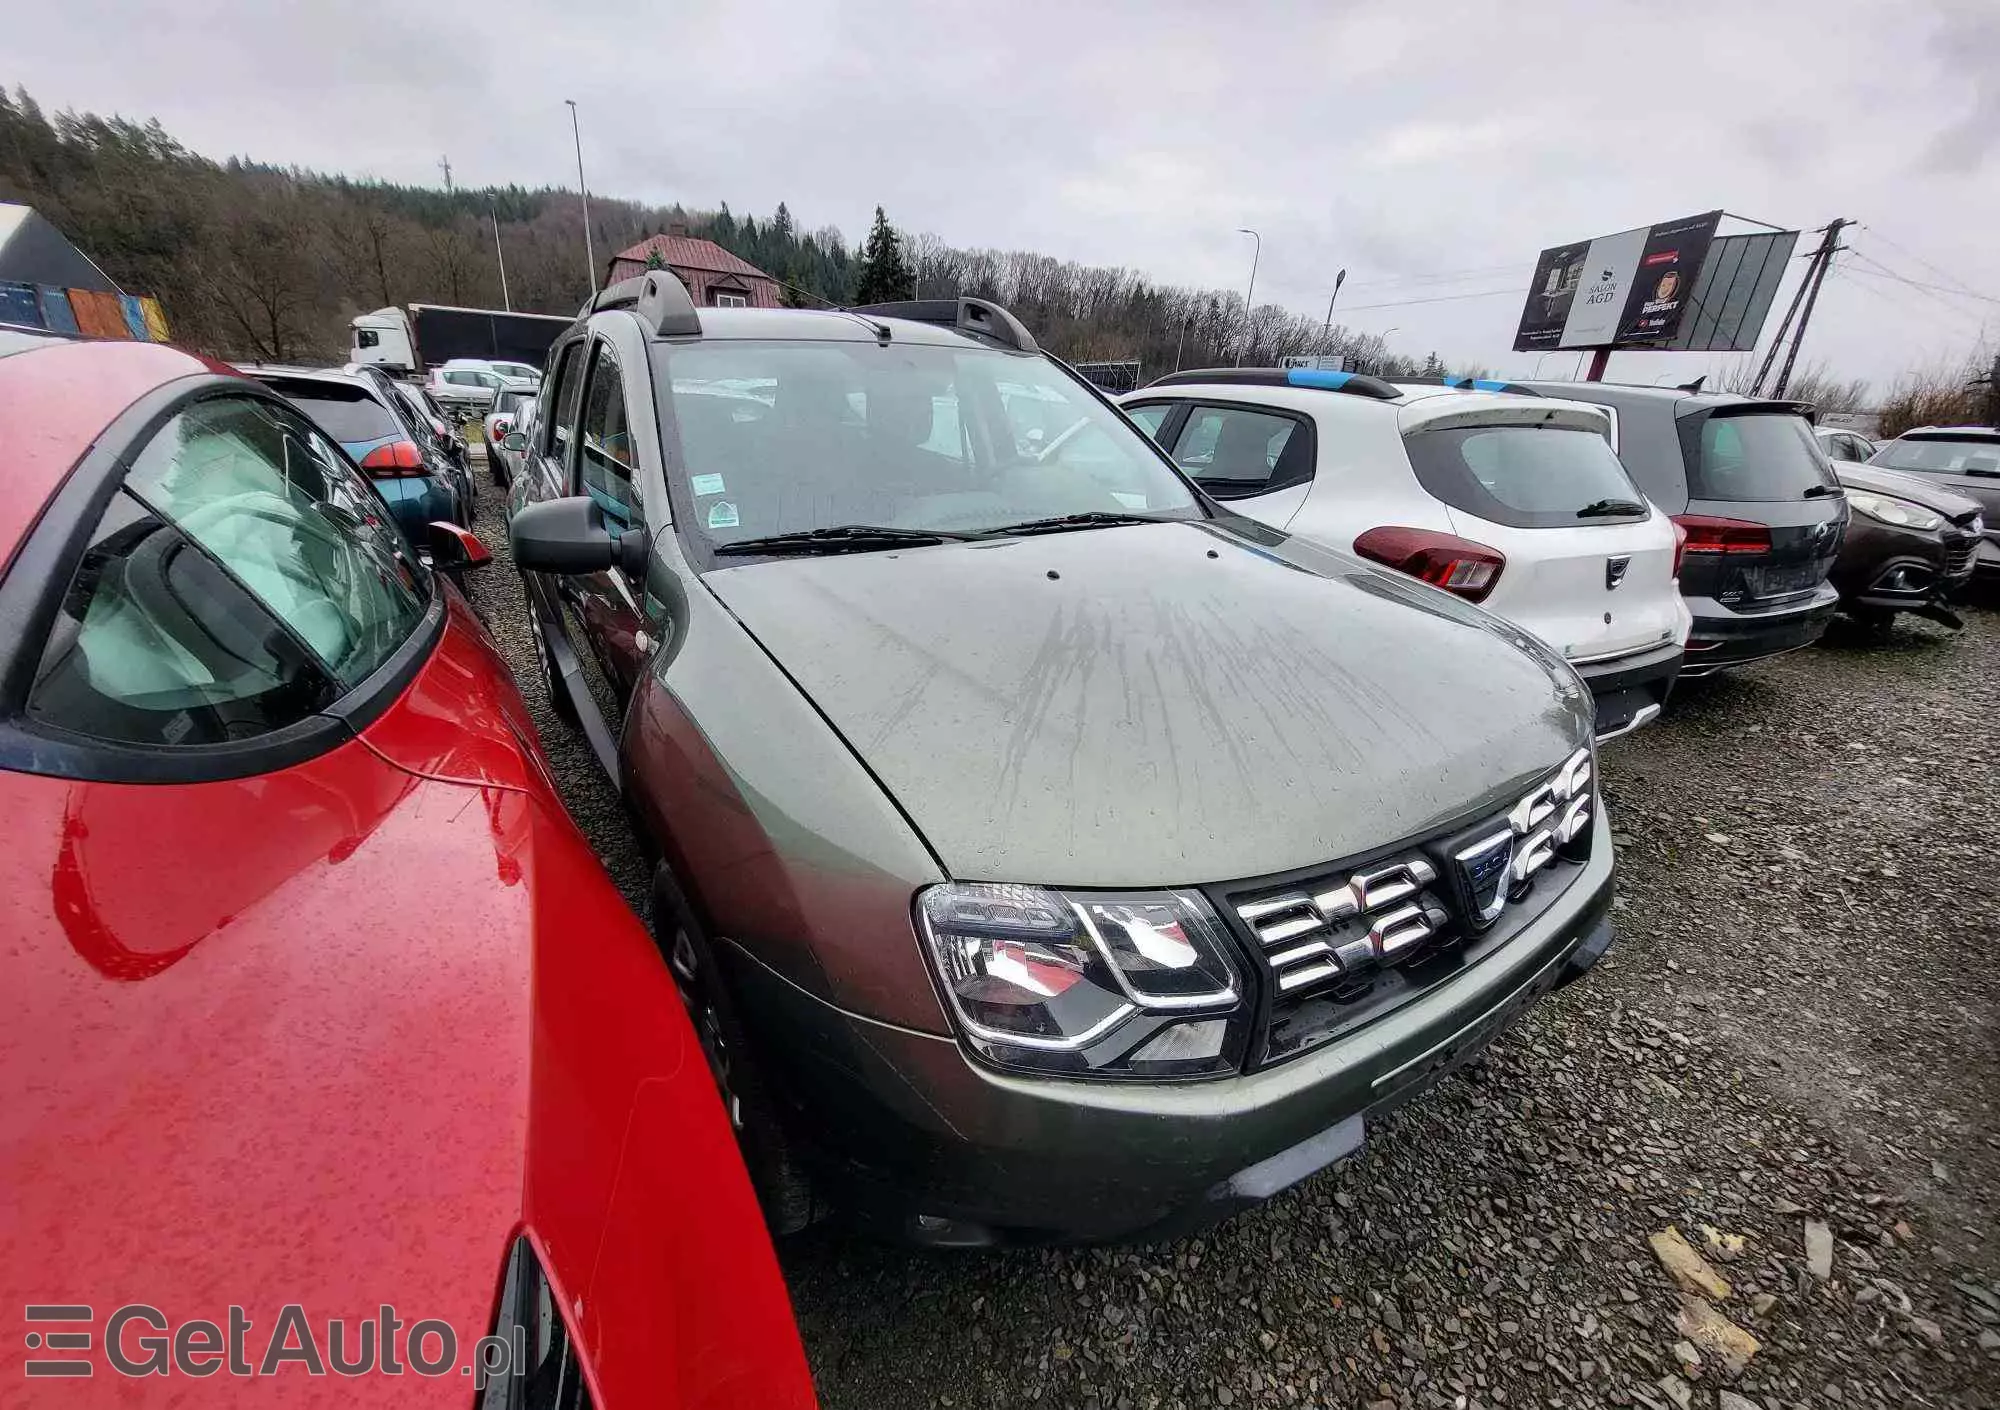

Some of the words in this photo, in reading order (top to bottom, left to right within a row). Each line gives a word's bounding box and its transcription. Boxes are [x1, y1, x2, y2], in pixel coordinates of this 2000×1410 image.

[1591, 283, 1617, 294] SALON
[1586, 292, 1613, 304] AGD
[1642, 301, 1679, 314] PERFEKT
